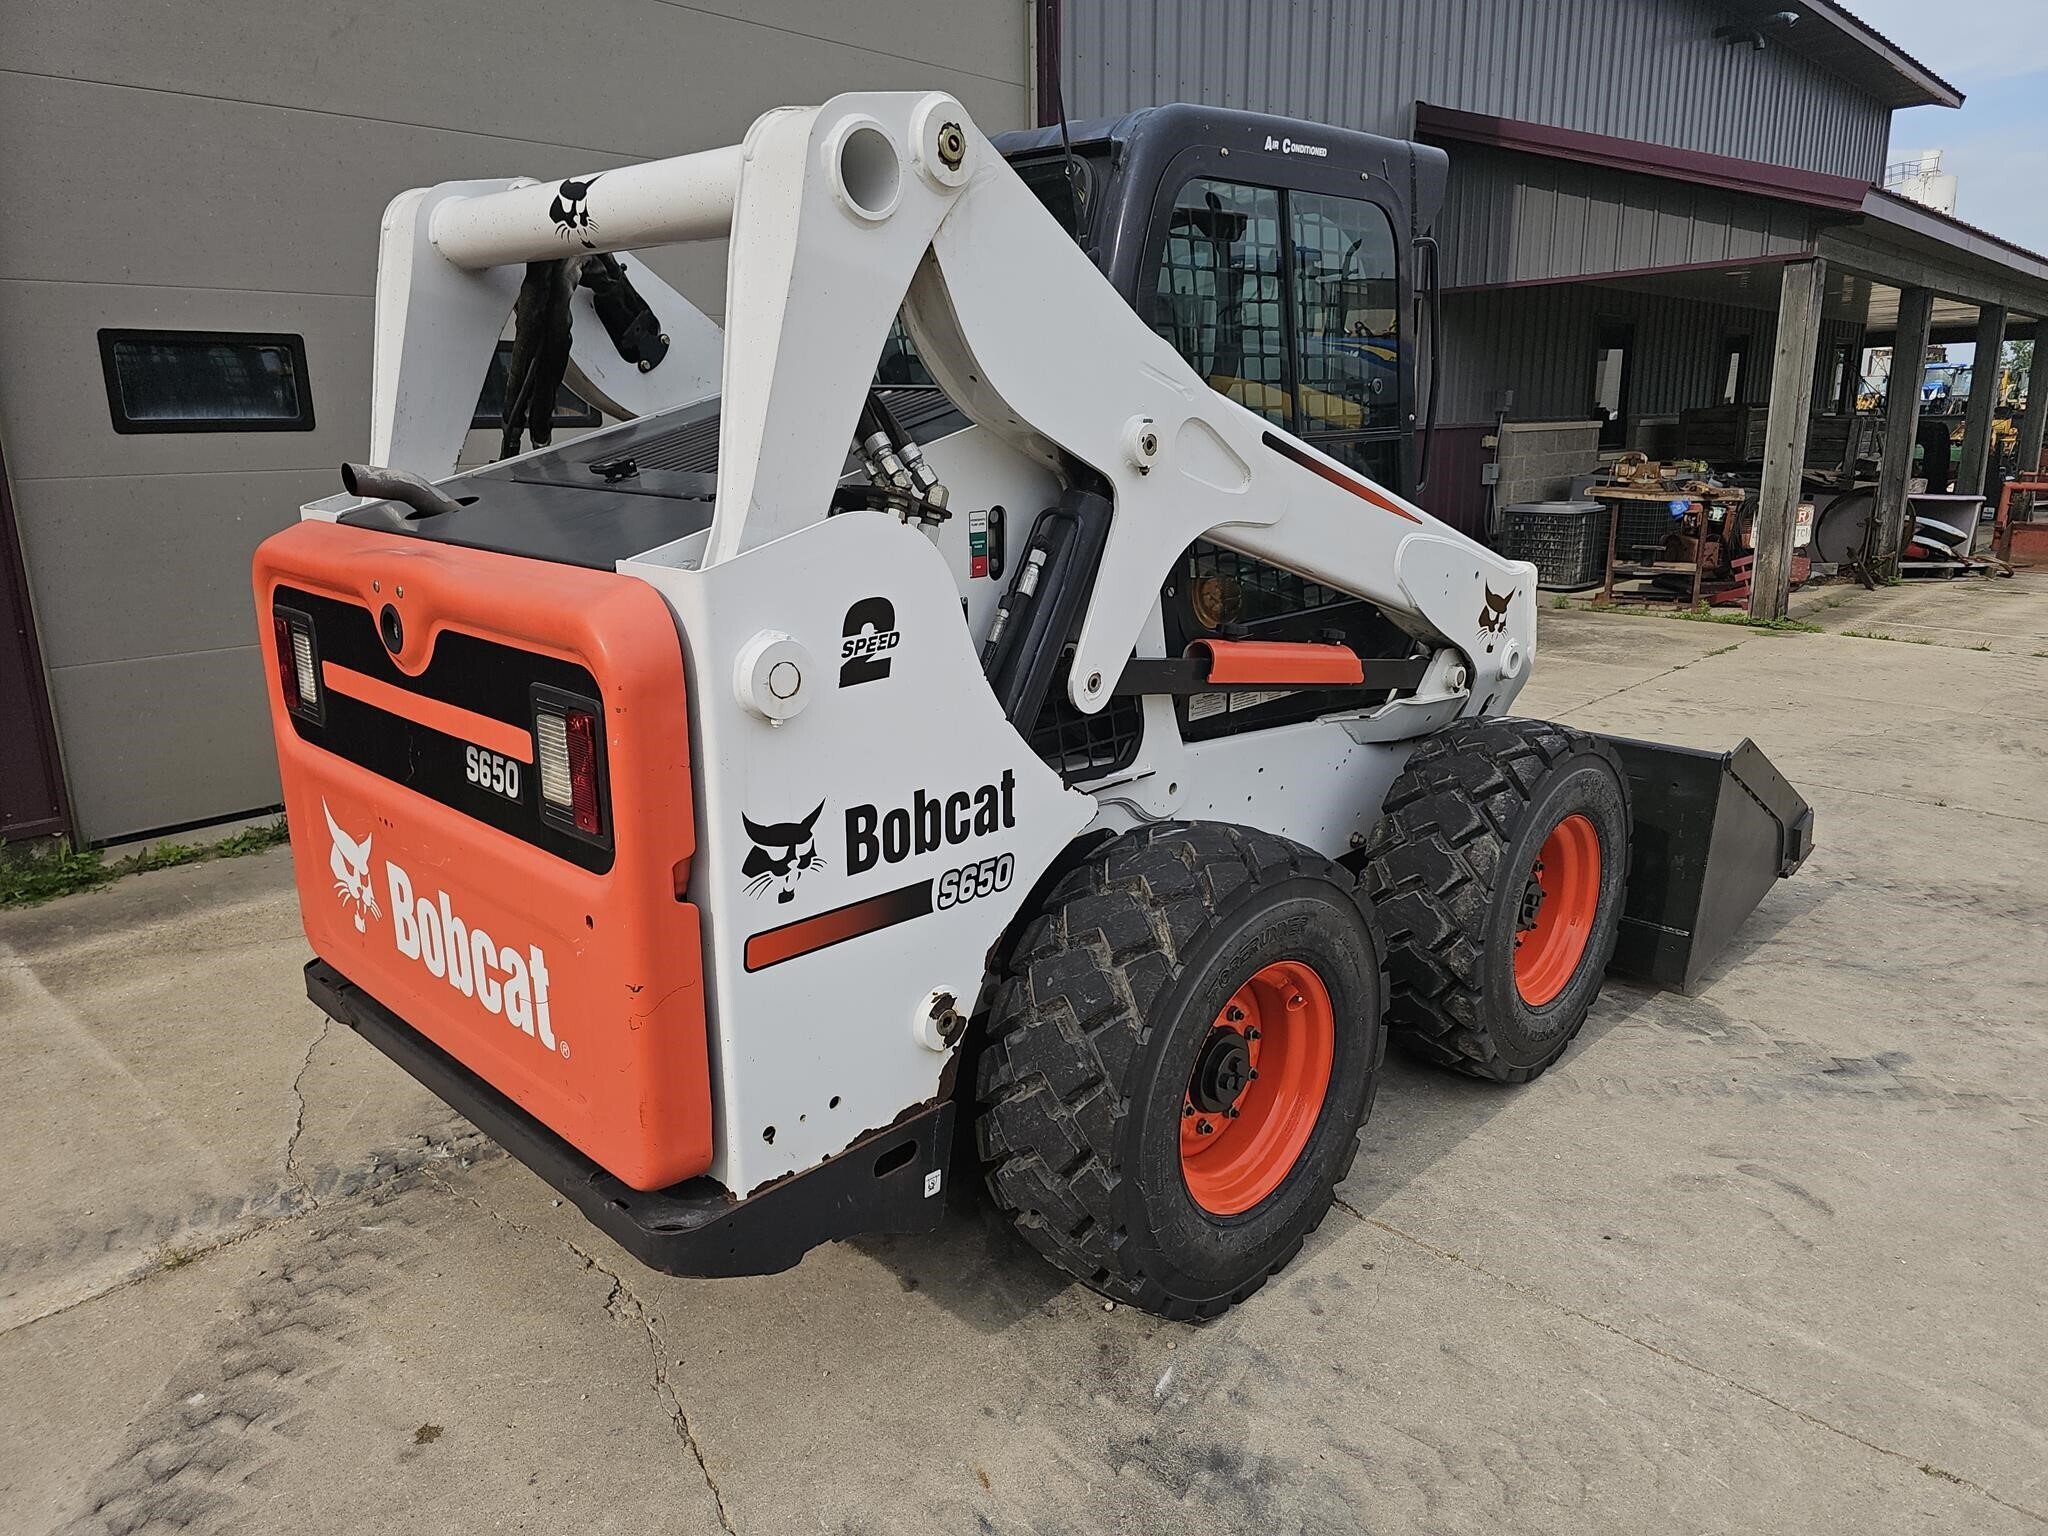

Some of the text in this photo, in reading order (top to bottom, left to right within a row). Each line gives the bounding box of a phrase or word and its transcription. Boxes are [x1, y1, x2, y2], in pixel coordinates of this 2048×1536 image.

[839, 596, 895, 688] 2
[841, 632, 900, 658] SPEED
[466, 745, 519, 799] S650
[845, 768, 1016, 877] Bobcat
[937, 852, 1015, 911] S650
[385, 860, 556, 1052] Bobcat
